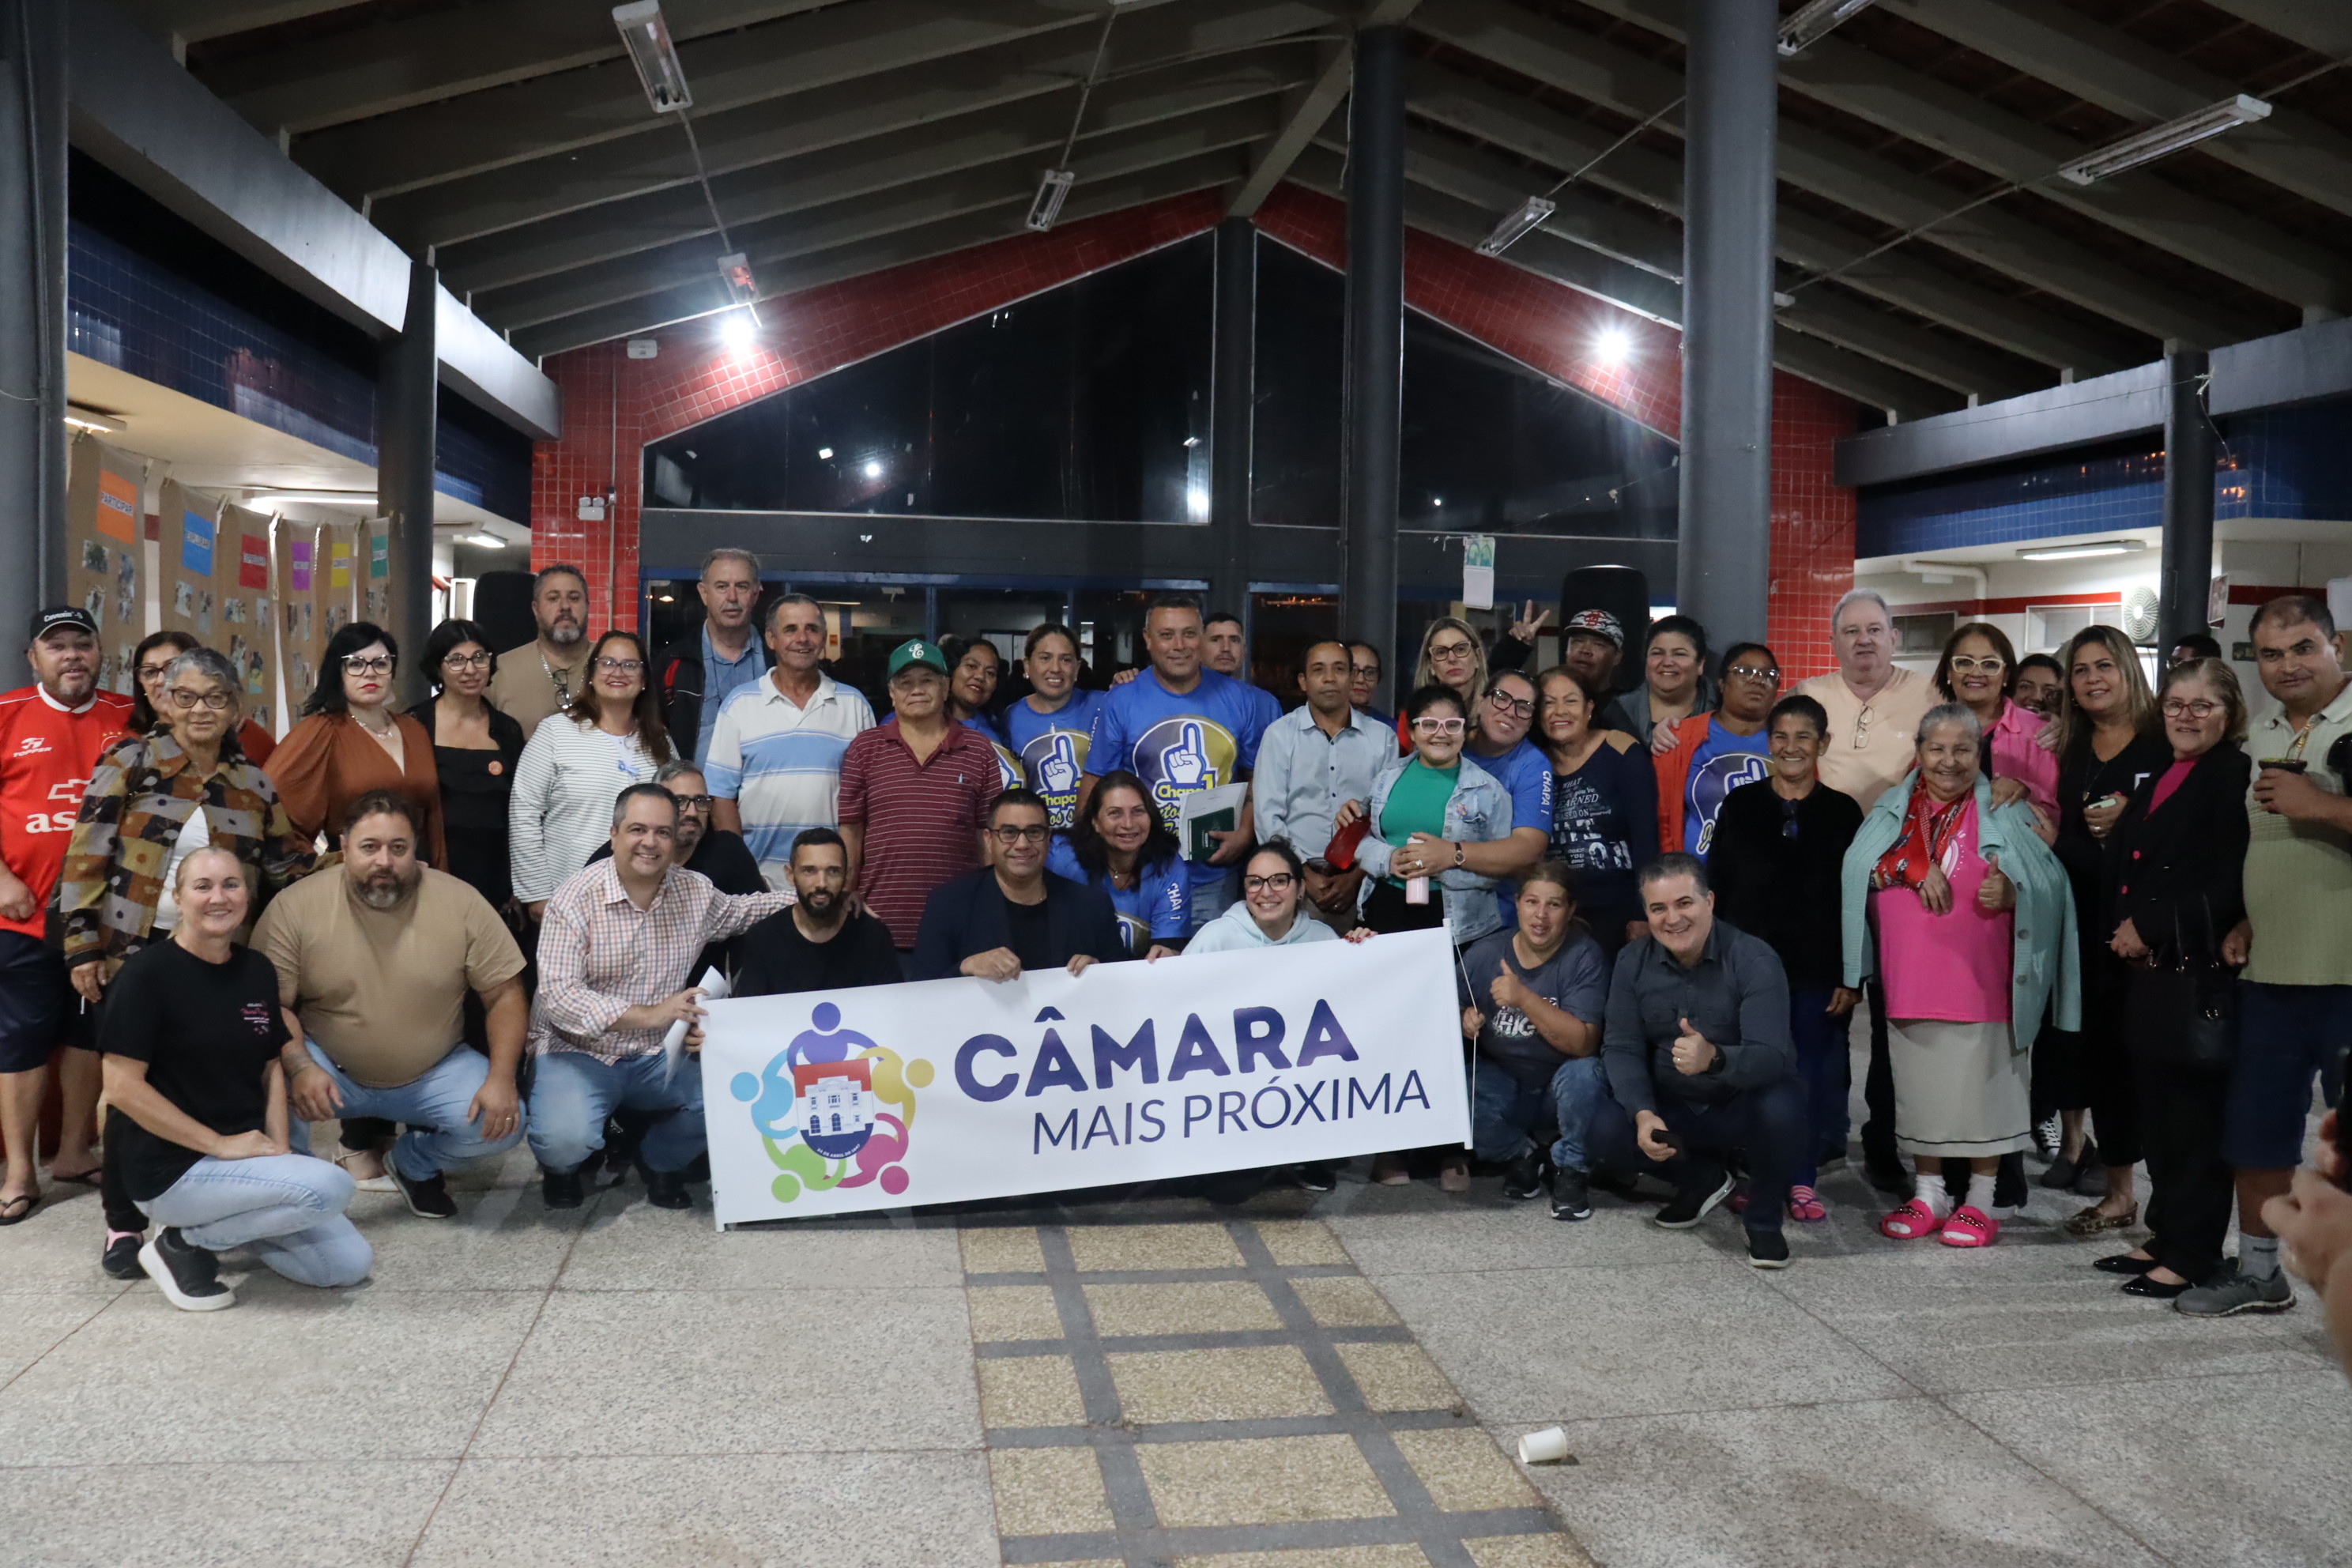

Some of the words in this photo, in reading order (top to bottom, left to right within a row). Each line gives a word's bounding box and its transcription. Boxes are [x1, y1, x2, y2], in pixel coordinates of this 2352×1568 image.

[13, 746, 53, 758] TOPPER
[1541, 770, 1551, 805] CHAPA
[1562, 777, 1583, 789] WHAT
[1578, 808, 1589, 817] ON
[954, 997, 1360, 1103] CÂMARA
[1033, 1099, 1166, 1155] MAIS
[1183, 1069, 1431, 1138] PRÓXIMA
